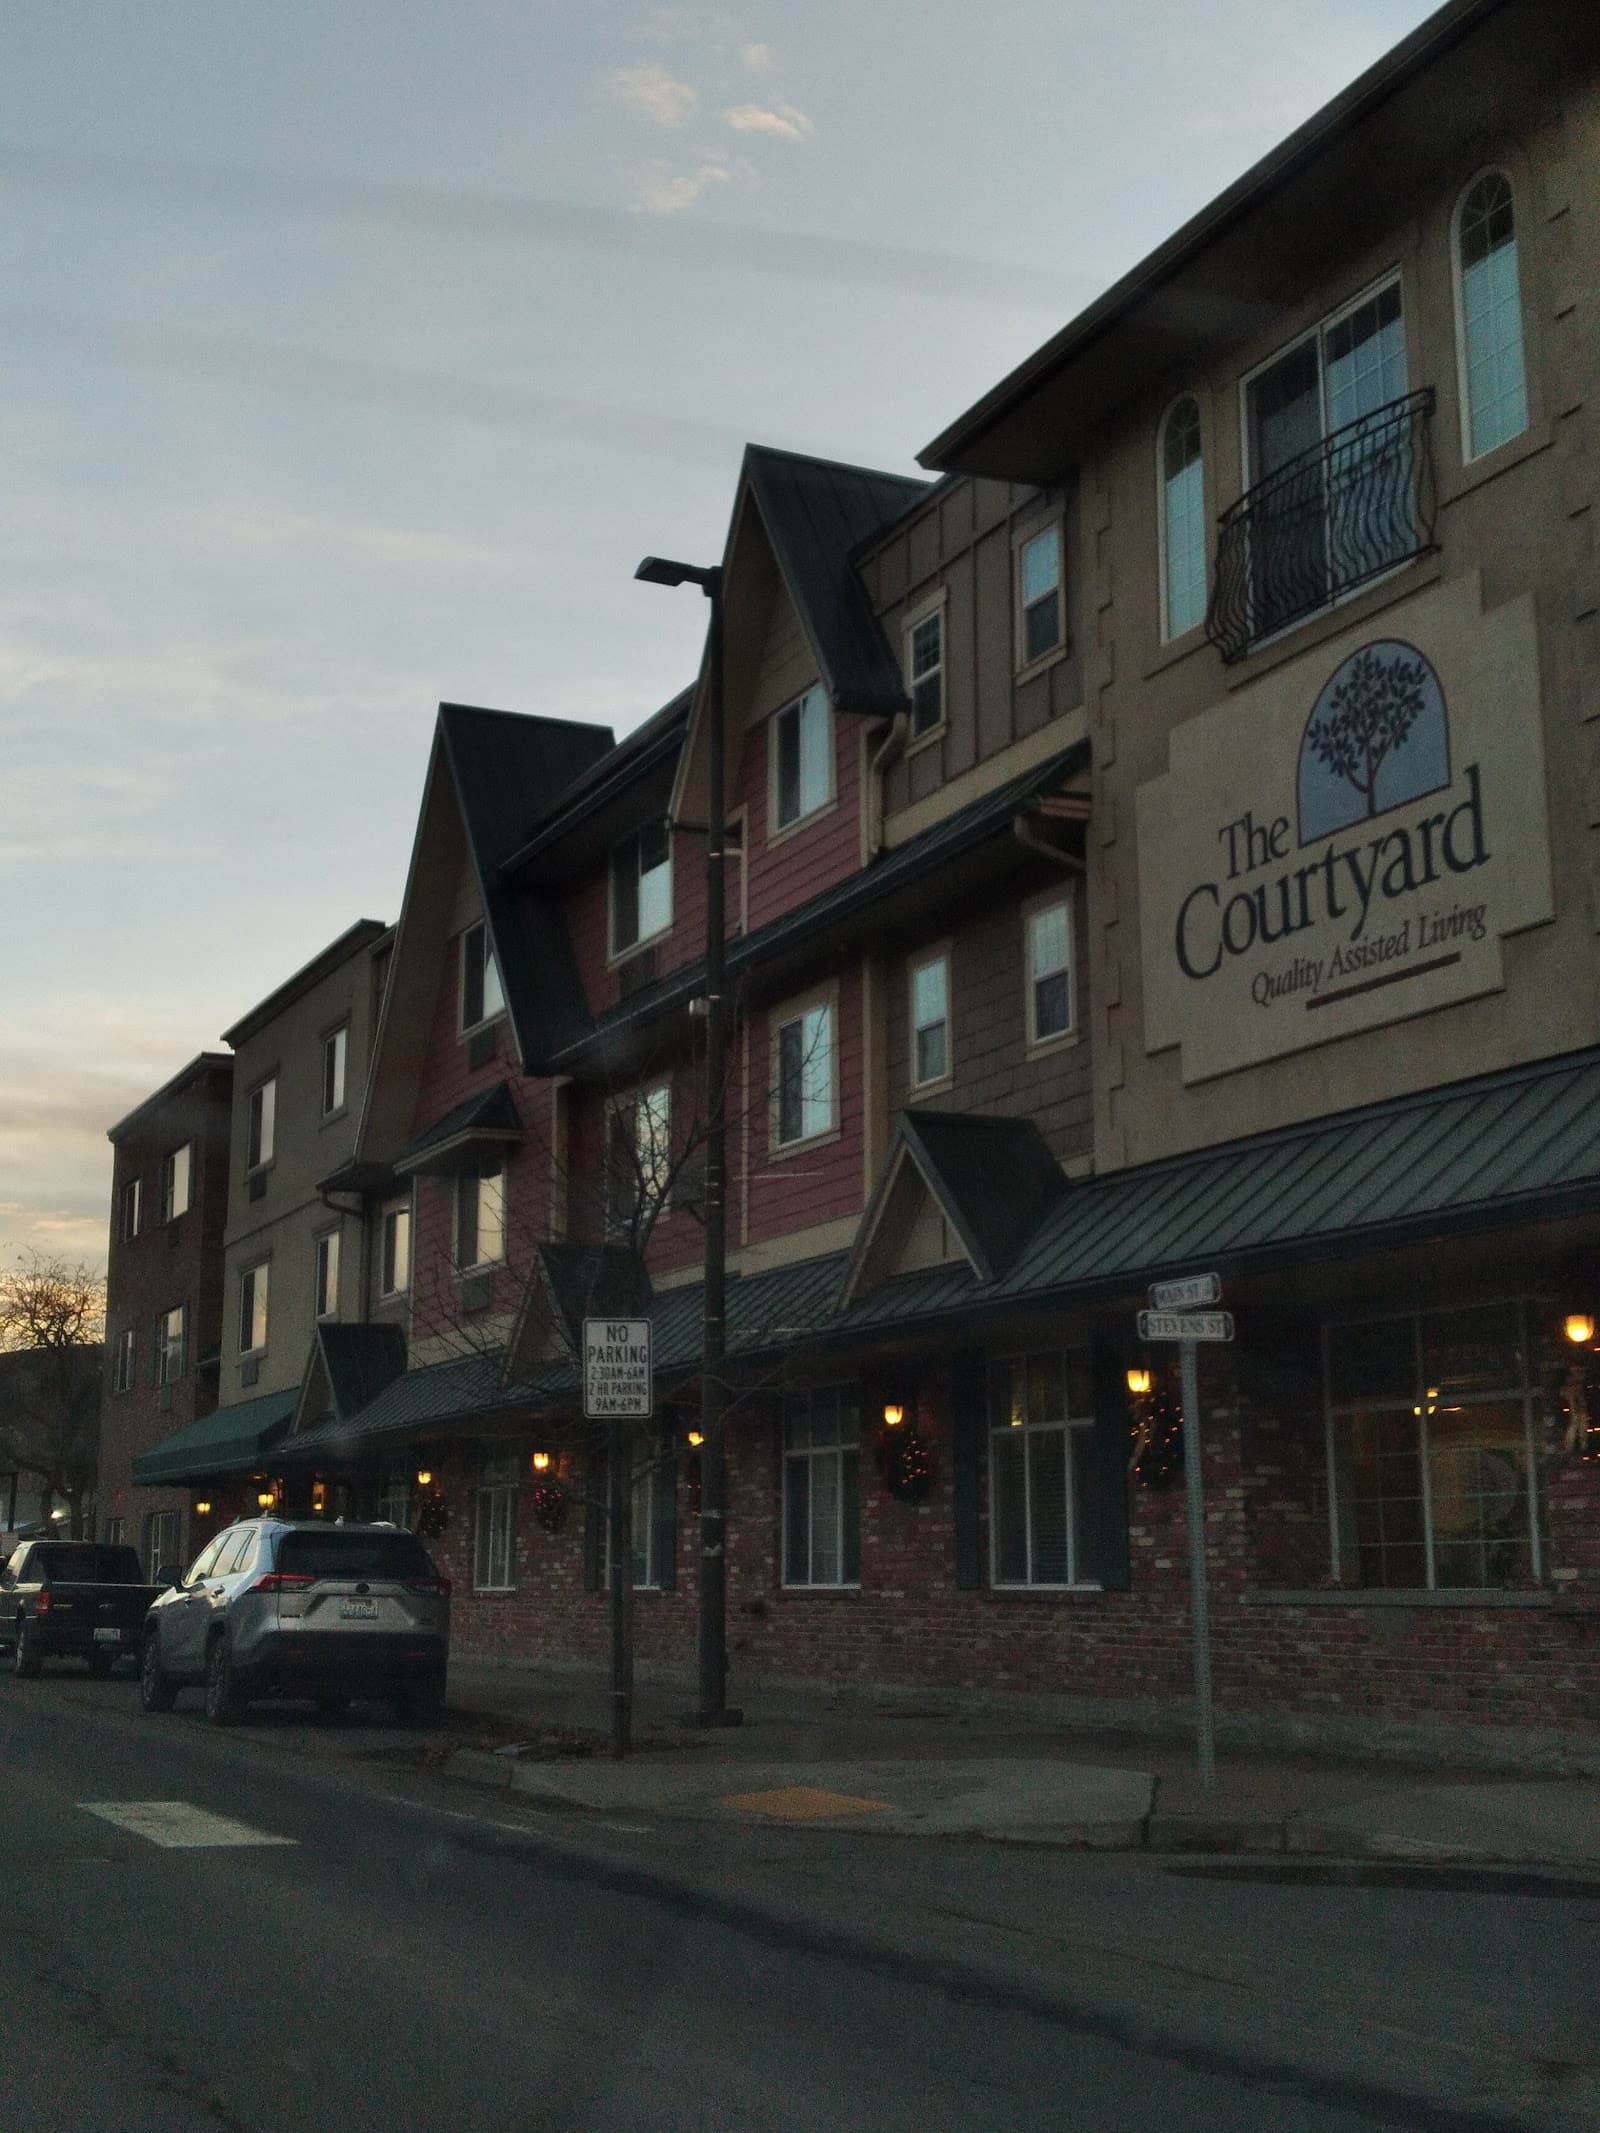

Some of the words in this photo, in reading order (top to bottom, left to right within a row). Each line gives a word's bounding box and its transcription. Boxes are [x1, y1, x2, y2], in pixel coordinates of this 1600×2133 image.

[1219, 811, 1289, 880] The
[1175, 763, 1491, 980] Courtyard
[1252, 959, 1323, 1007] Quality
[1328, 922, 1410, 977] Assisted
[1418, 904, 1487, 950] Living
[607, 1325, 628, 1342] NO
[1150, 1319, 1204, 1334] STEVENS
[1208, 1319, 1222, 1334] ST
[588, 1345, 648, 1363] PARKING
[589, 1382, 595, 1396] 2
[597, 1382, 609, 1396] HR
[611, 1382, 648, 1396] PARKING
[595, 1397, 641, 1411] 9AM-6PM
